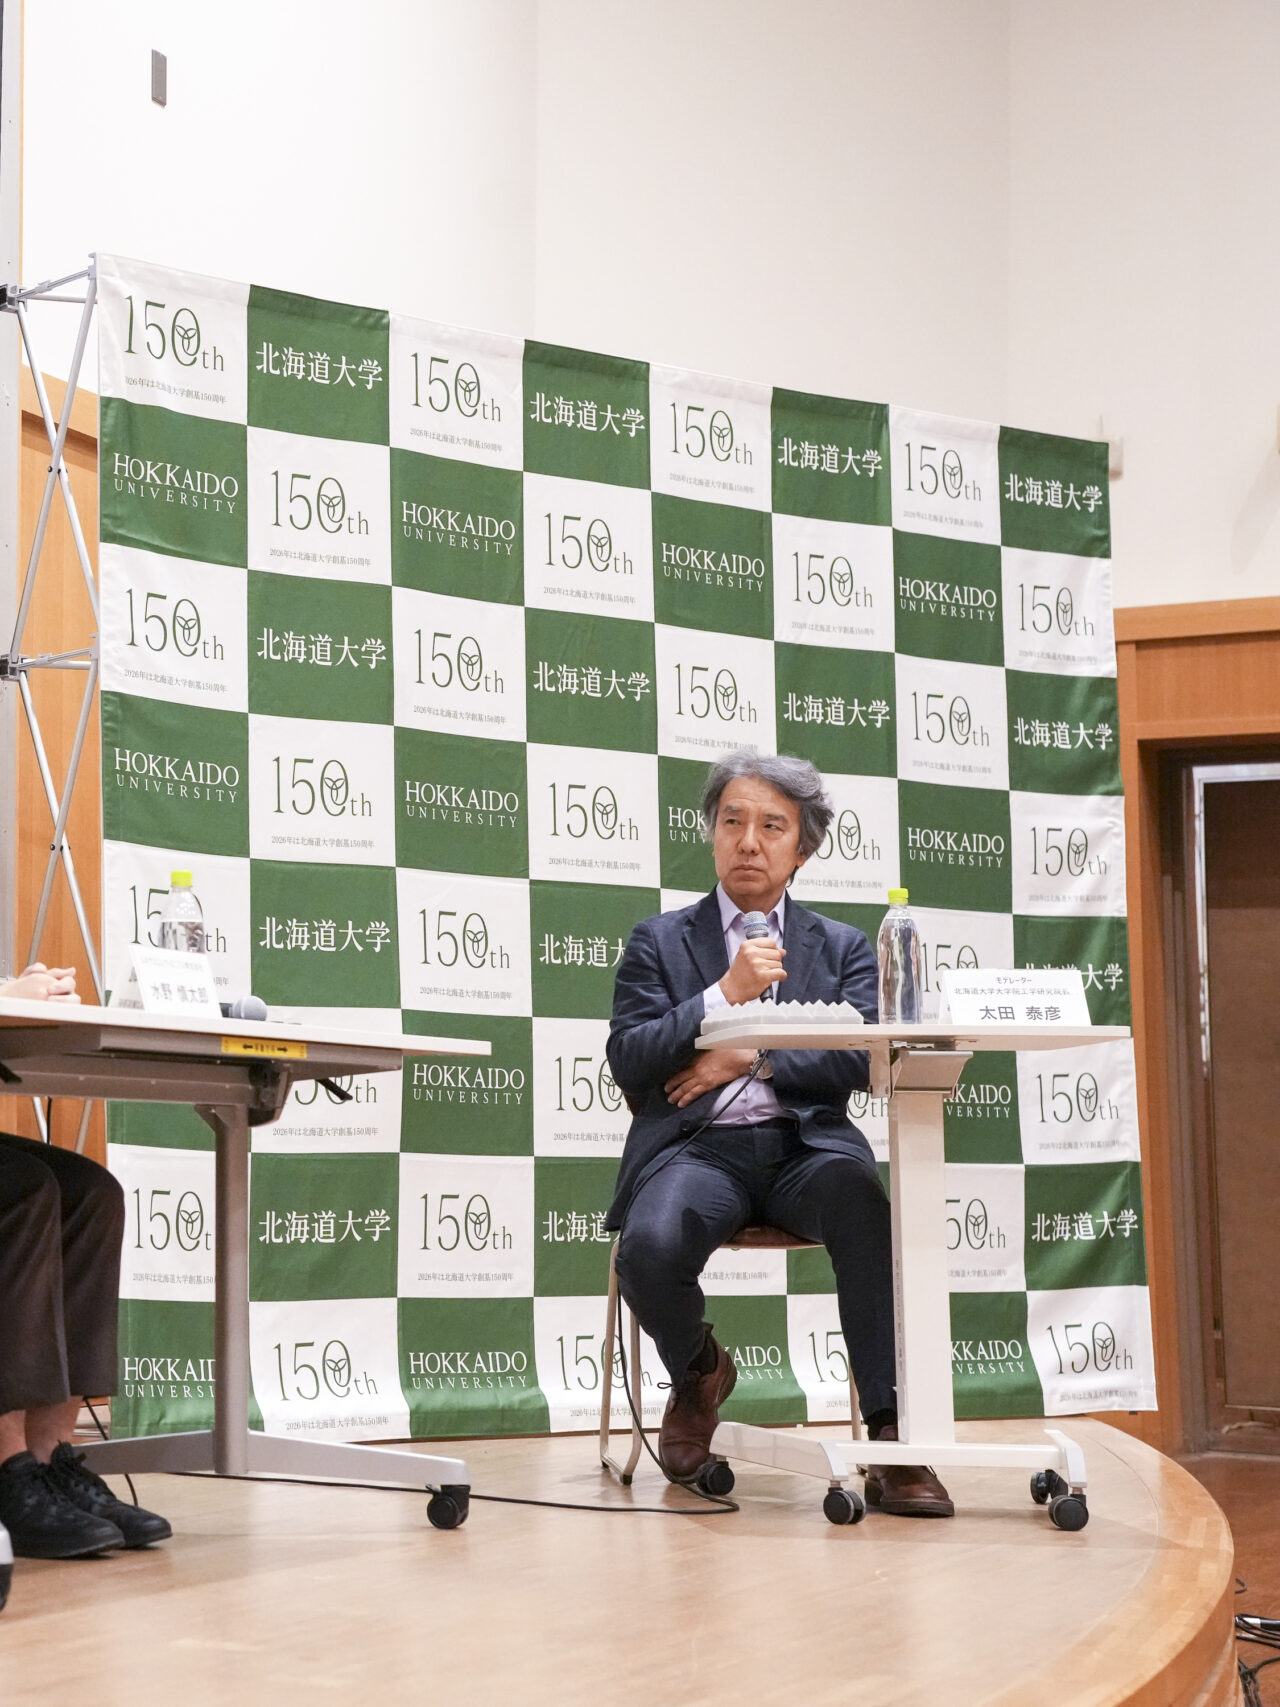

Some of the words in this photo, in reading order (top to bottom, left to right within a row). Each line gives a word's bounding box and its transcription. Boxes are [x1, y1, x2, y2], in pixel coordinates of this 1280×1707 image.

[125, 296, 223, 371] 150th
[256, 342, 382, 389] 北海道大学
[411, 353, 500, 422] 150th
[531, 392, 644, 437] 北海道大学
[671, 402, 752, 465] 150th
[114, 452, 239, 498] HOKKAIDO
[778, 437, 882, 477] 北海道大学
[905, 443, 981, 500] 150th
[114, 479, 236, 514] UNIVERSITY
[272, 470, 368, 535] 150th
[1006, 473, 1102, 512] 北海道大学
[402, 501, 515, 540] HOKKAIDO
[403, 526, 514, 555] UNIVERSITY
[544, 513, 632, 574] 150th
[661, 542, 765, 579] HOKKAIDO
[664, 566, 764, 592] UNIVERSITY
[793, 552, 872, 607] 150th
[898, 576, 997, 609] HOKKAIDO
[126, 589, 223, 660] 150th
[900, 598, 996, 622] UNIVERSITY
[1019, 584, 1094, 636] 150th
[257, 628, 386, 669] 北海道大学
[415, 629, 504, 693] 150th
[534, 661, 650, 701] 北海道大学
[675, 664, 756, 723] 150th
[784, 693, 889, 728] 北海道大学
[912, 691, 989, 746] 150th
[1015, 717, 1112, 750] 北海道大学
[115, 747, 239, 787] HOKKAIDO
[273, 756, 371, 816] 150th
[116, 774, 237, 803] UNIVERSITY
[405, 780, 519, 813] HOKKAIDO
[406, 805, 518, 828] UNIVERSITY
[549, 783, 638, 840] 150th
[907, 826, 1005, 856] HOKKAIDO
[909, 849, 1004, 869] UNIVERSITY
[1031, 827, 1107, 876] 150th
[259, 917, 390, 952] 北海道大学
[419, 909, 509, 968] 150th
[979, 1005, 1016, 1021] 太田
[1025, 1005, 1062, 1021] 泰彦
[413, 1063, 525, 1090] HOKKAIDO
[413, 1088, 523, 1105] UNIVERSITY
[944, 1083, 1012, 1105] KAIDO
[1037, 1073, 1118, 1123] 150th
[259, 1209, 390, 1244] 北海道大学
[421, 1193, 512, 1251] 150th
[1032, 1209, 1138, 1241] 北海道大学
[410, 1351, 527, 1374] HOKKAIDO
[725, 1345, 782, 1367] AIDO
[1047, 1322, 1133, 1374] 150th
[274, 1340, 378, 1400] 150th
[412, 1375, 527, 1389] UNIVERSITY
